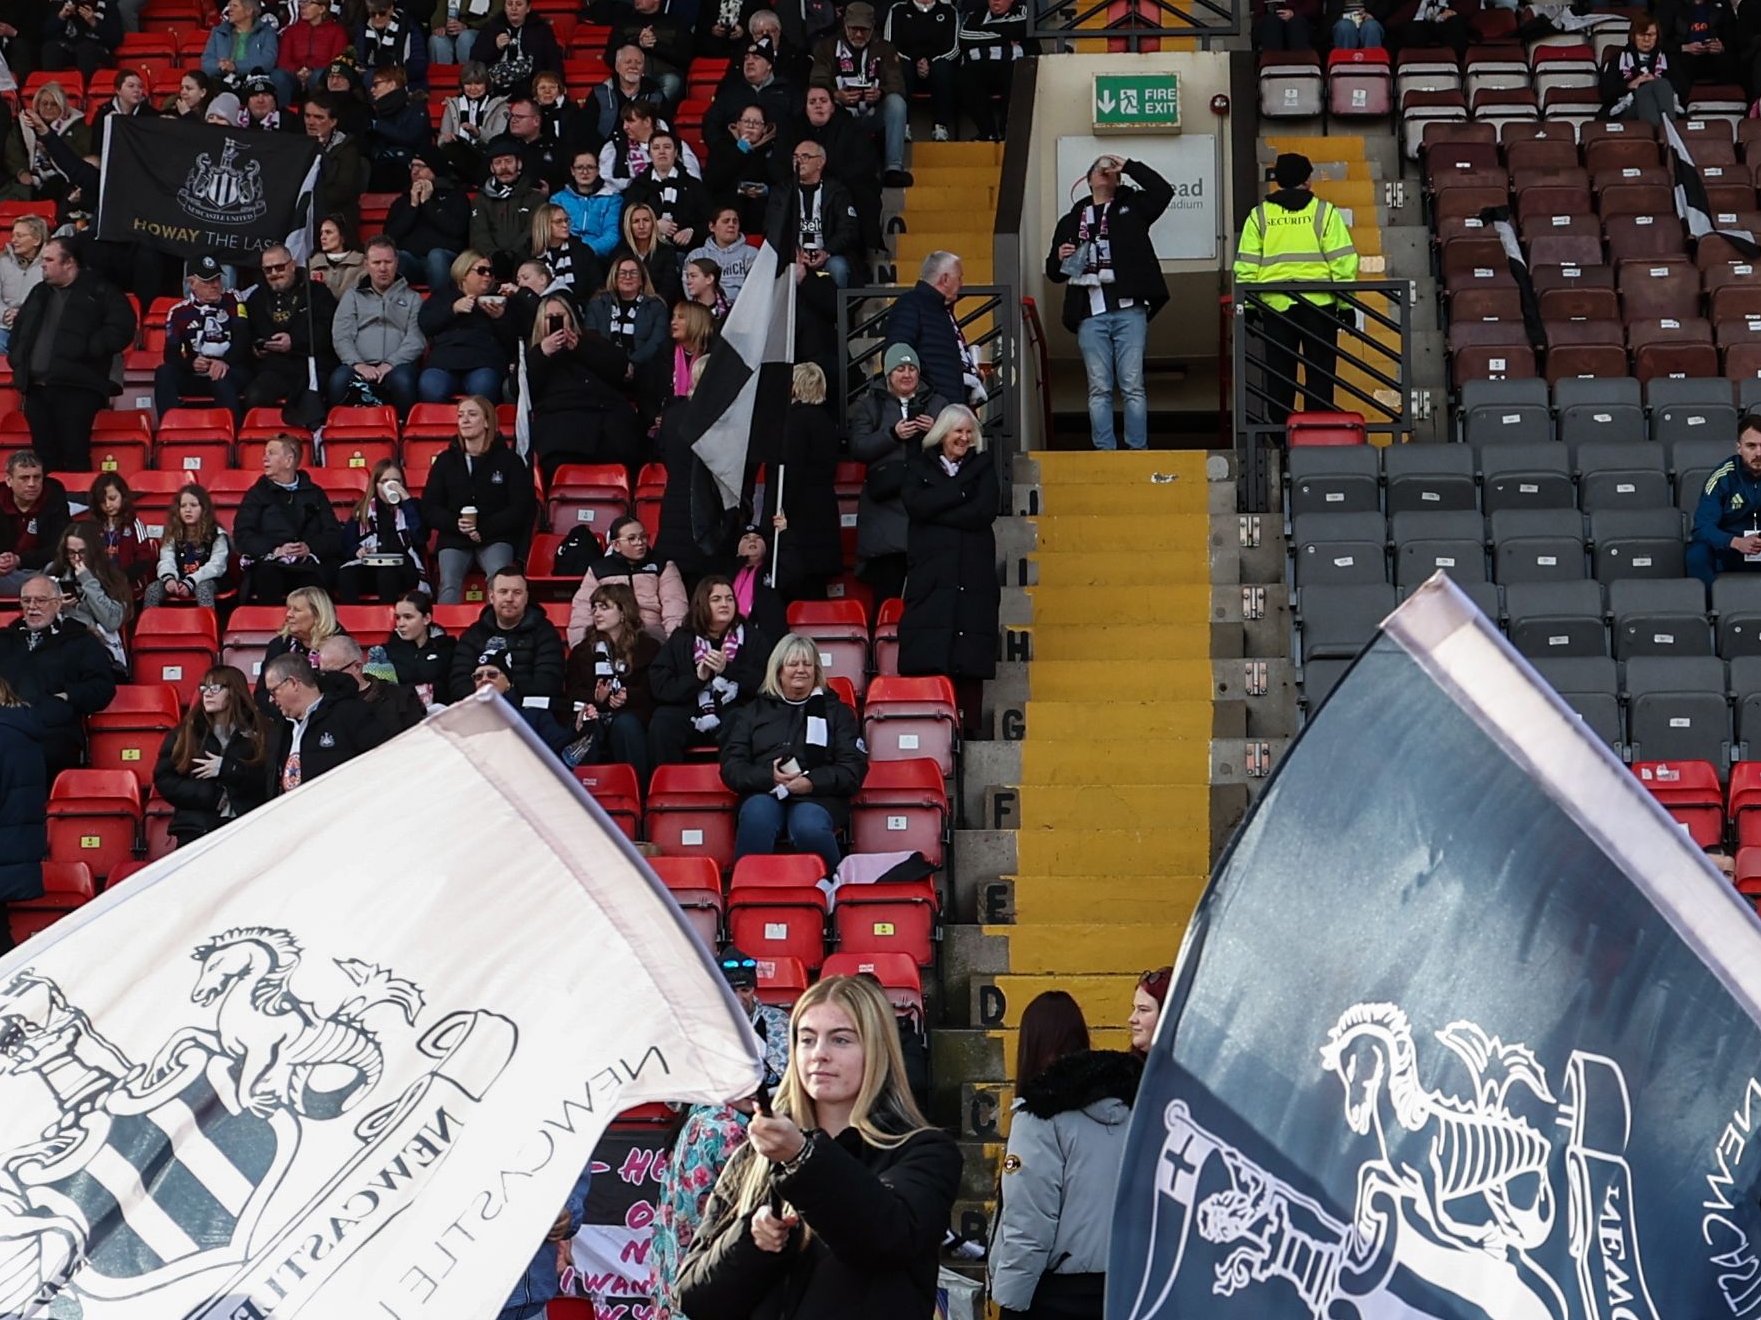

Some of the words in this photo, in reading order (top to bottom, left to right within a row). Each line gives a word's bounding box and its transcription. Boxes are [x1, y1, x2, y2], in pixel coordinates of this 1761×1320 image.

[1144, 88, 1177, 100] FIRE
[1144, 101, 1177, 114] EXIT
[133, 218, 200, 243] HOWAY
[205, 231, 238, 250] THE
[1265, 214, 1315, 228] SECURITY
[1006, 629, 1030, 662] H
[1002, 709, 1026, 741] G
[993, 792, 1016, 830] F
[986, 884, 1009, 925] E
[978, 984, 1008, 1027] D
